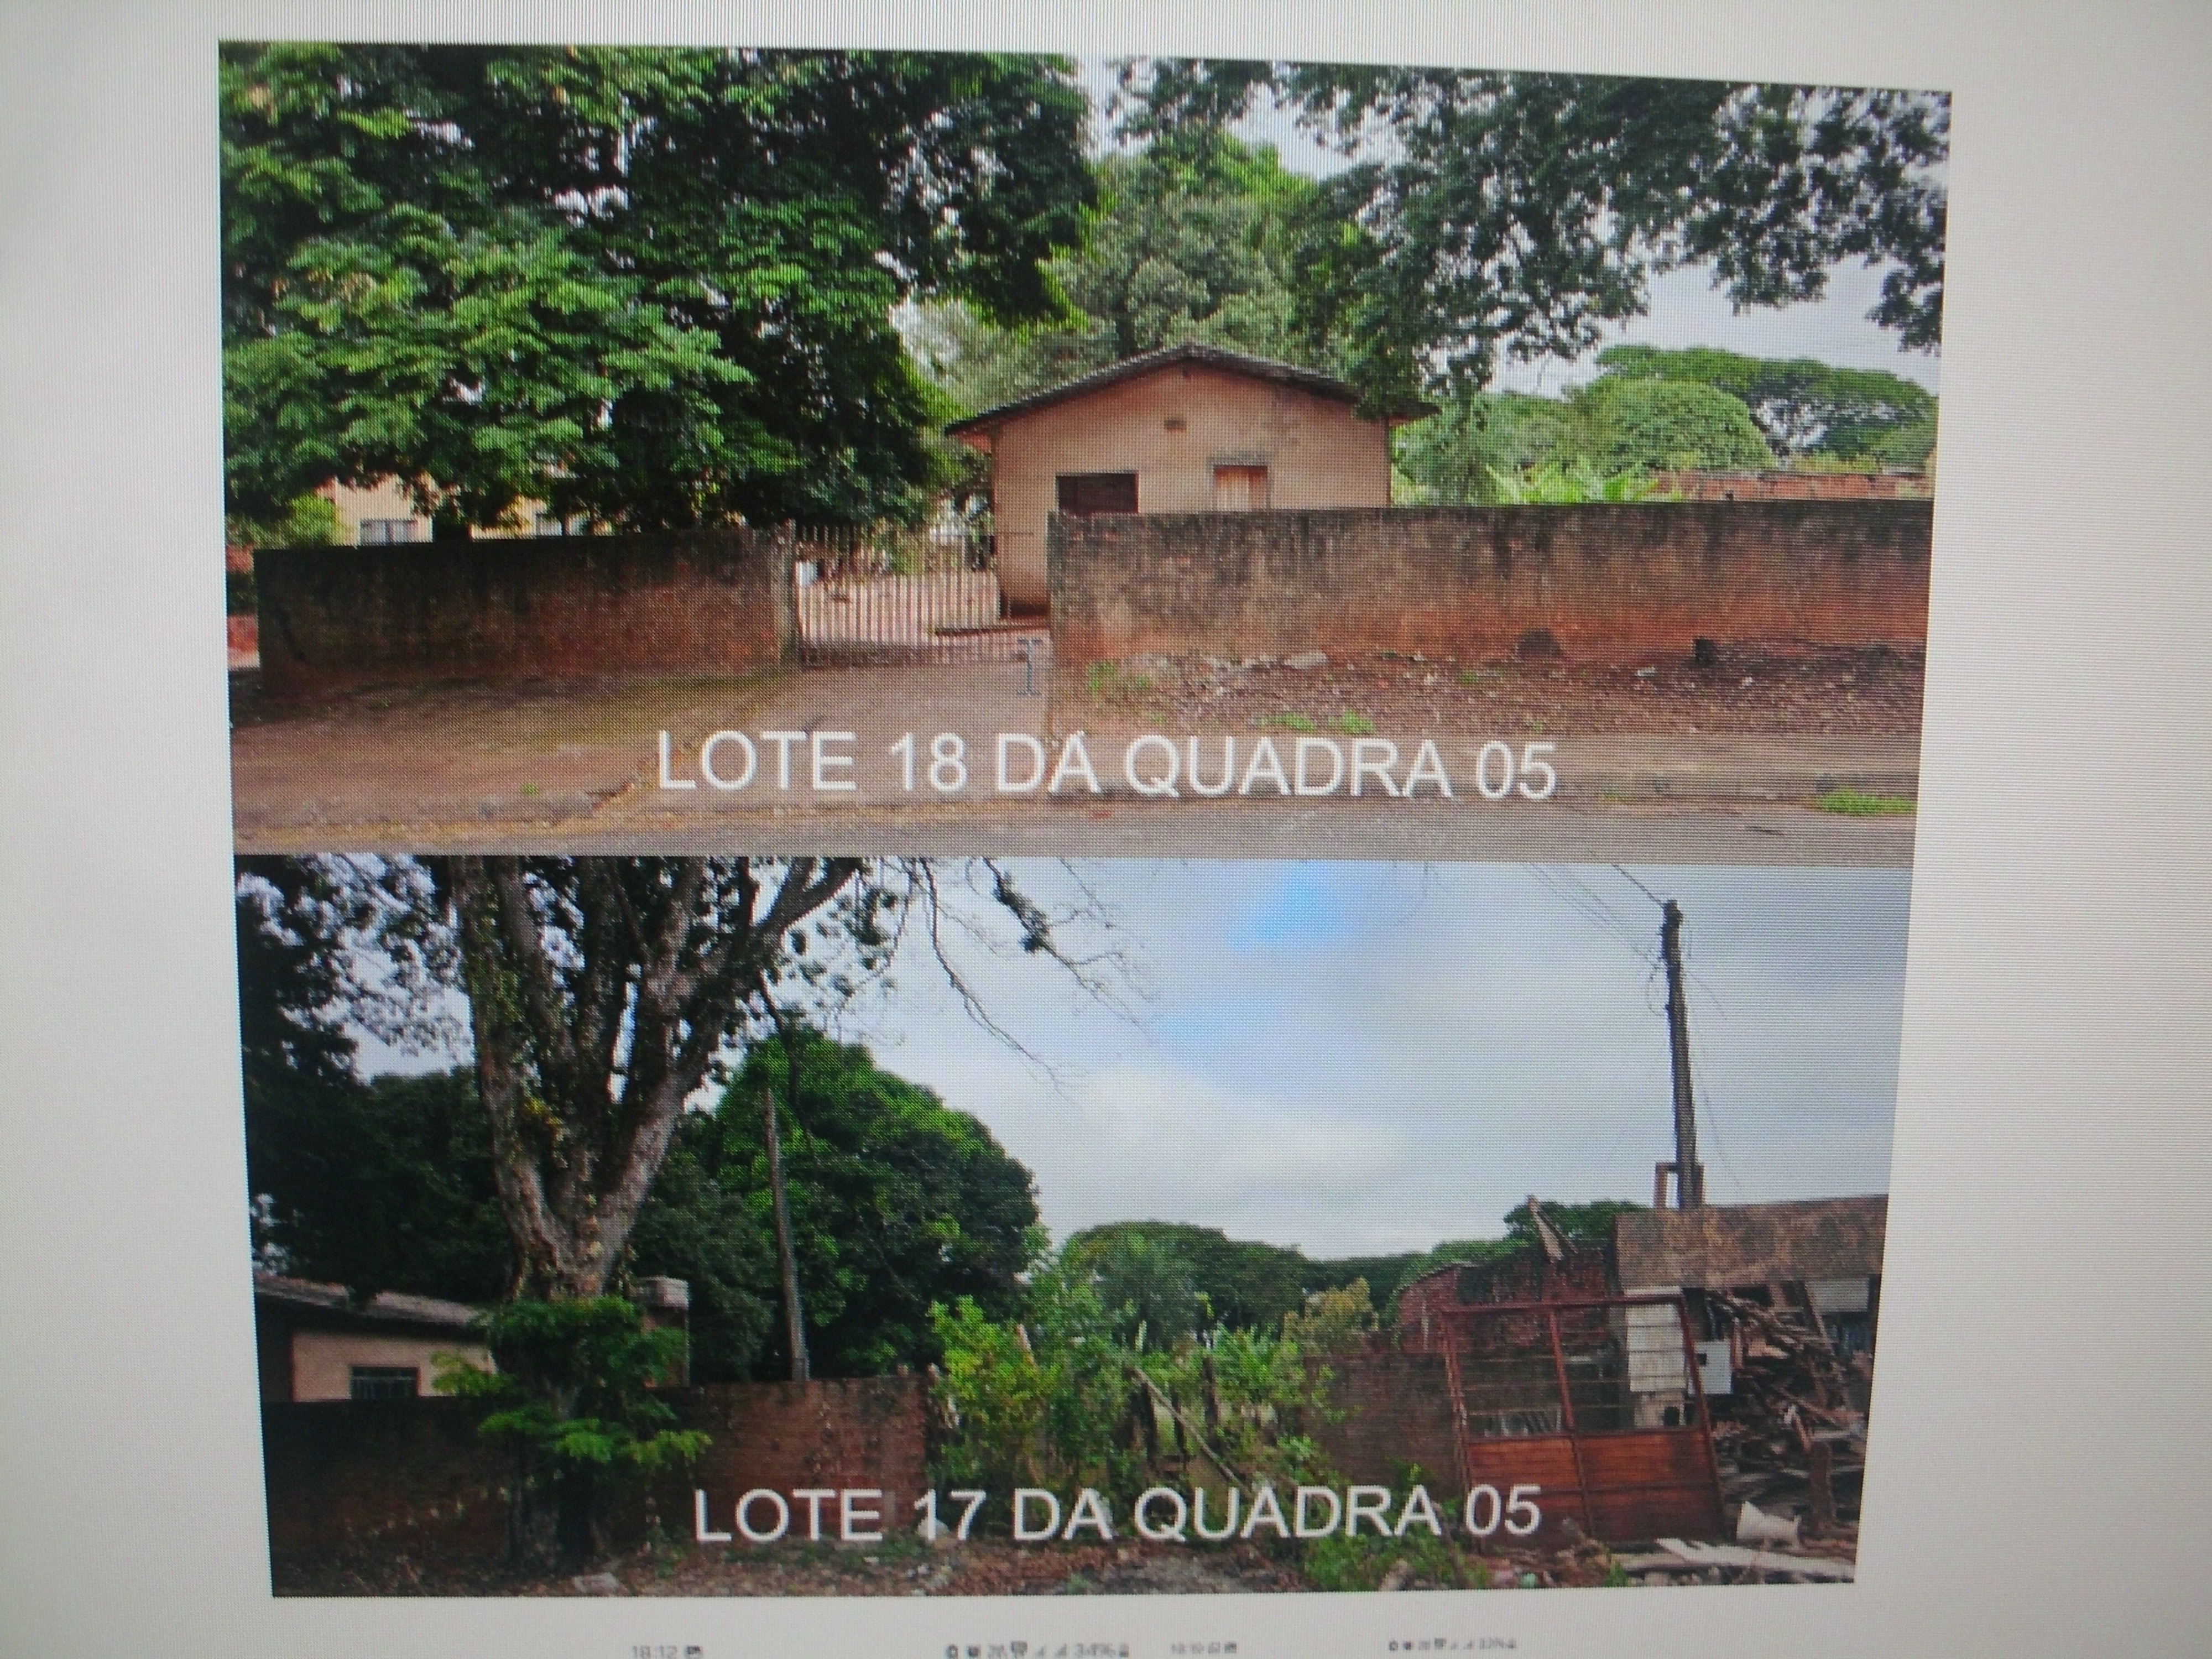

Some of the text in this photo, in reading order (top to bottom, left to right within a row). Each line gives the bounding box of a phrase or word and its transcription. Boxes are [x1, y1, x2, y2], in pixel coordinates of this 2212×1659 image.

[658, 729, 1557, 800] LOTE 18 DA QUADRA 05
[695, 1484, 1542, 1542] LOTE 17 DA QUADRA 05
